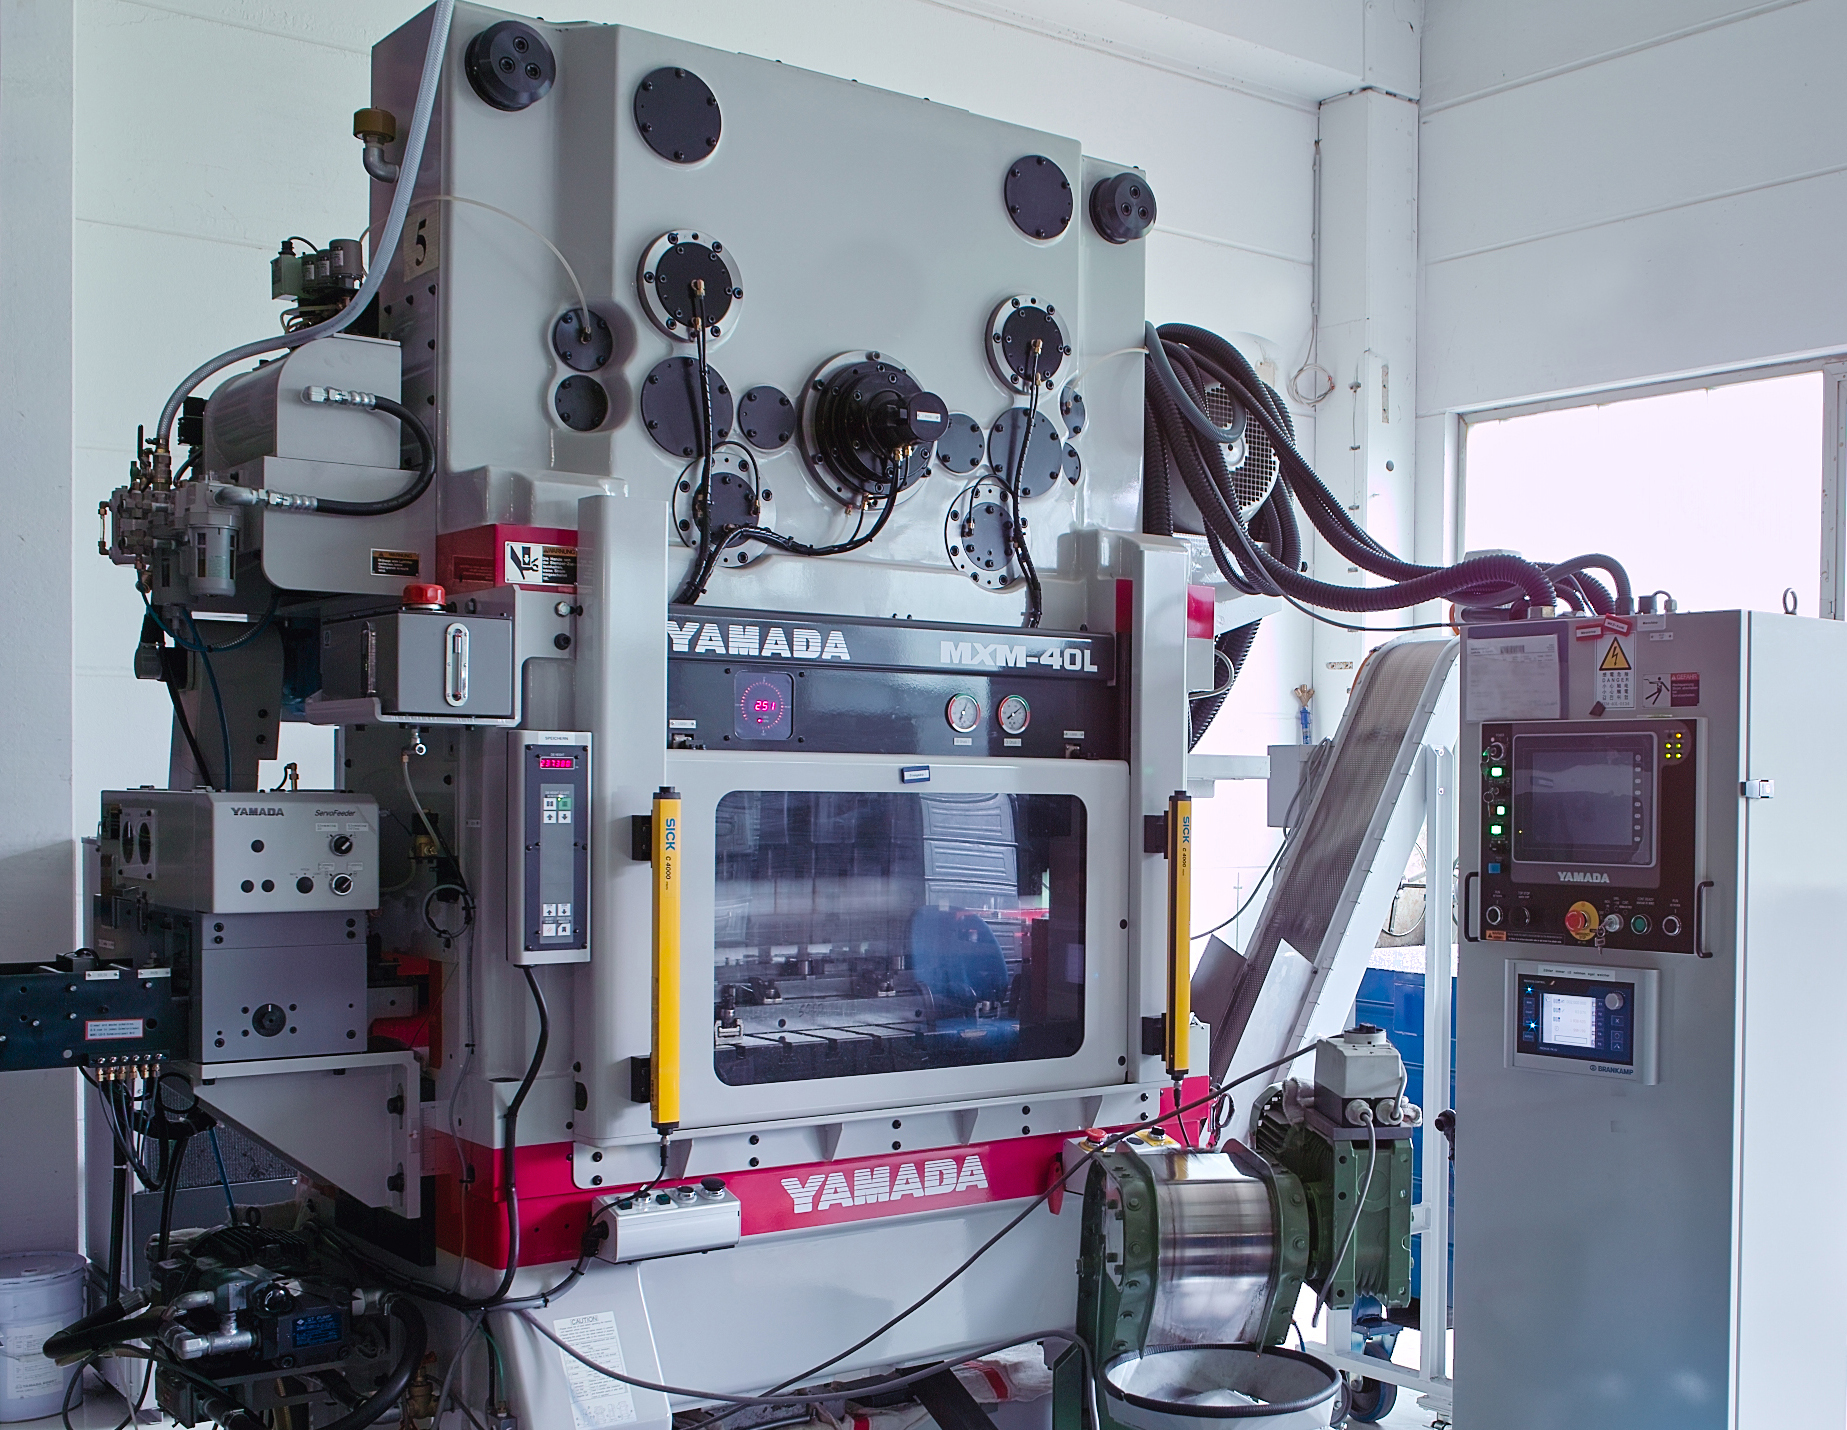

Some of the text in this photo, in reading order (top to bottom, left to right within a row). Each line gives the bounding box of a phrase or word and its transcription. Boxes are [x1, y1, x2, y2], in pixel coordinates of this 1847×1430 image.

[415, 218, 427, 267] 5
[667, 621, 850, 660] YAMADA
[940, 640, 1098, 672] MXM-40L
[754, 700, 776, 711] 251
[230, 807, 285, 816] YAMADA
[665, 818, 676, 851] SICK
[1182, 816, 1190, 844] SICK
[1557, 871, 1610, 884] YAMADA
[1597, 1065, 1634, 1076] BRANKAMP
[781, 1155, 988, 1213] YAMADA
[571, 1315, 599, 1326] CAUTION
